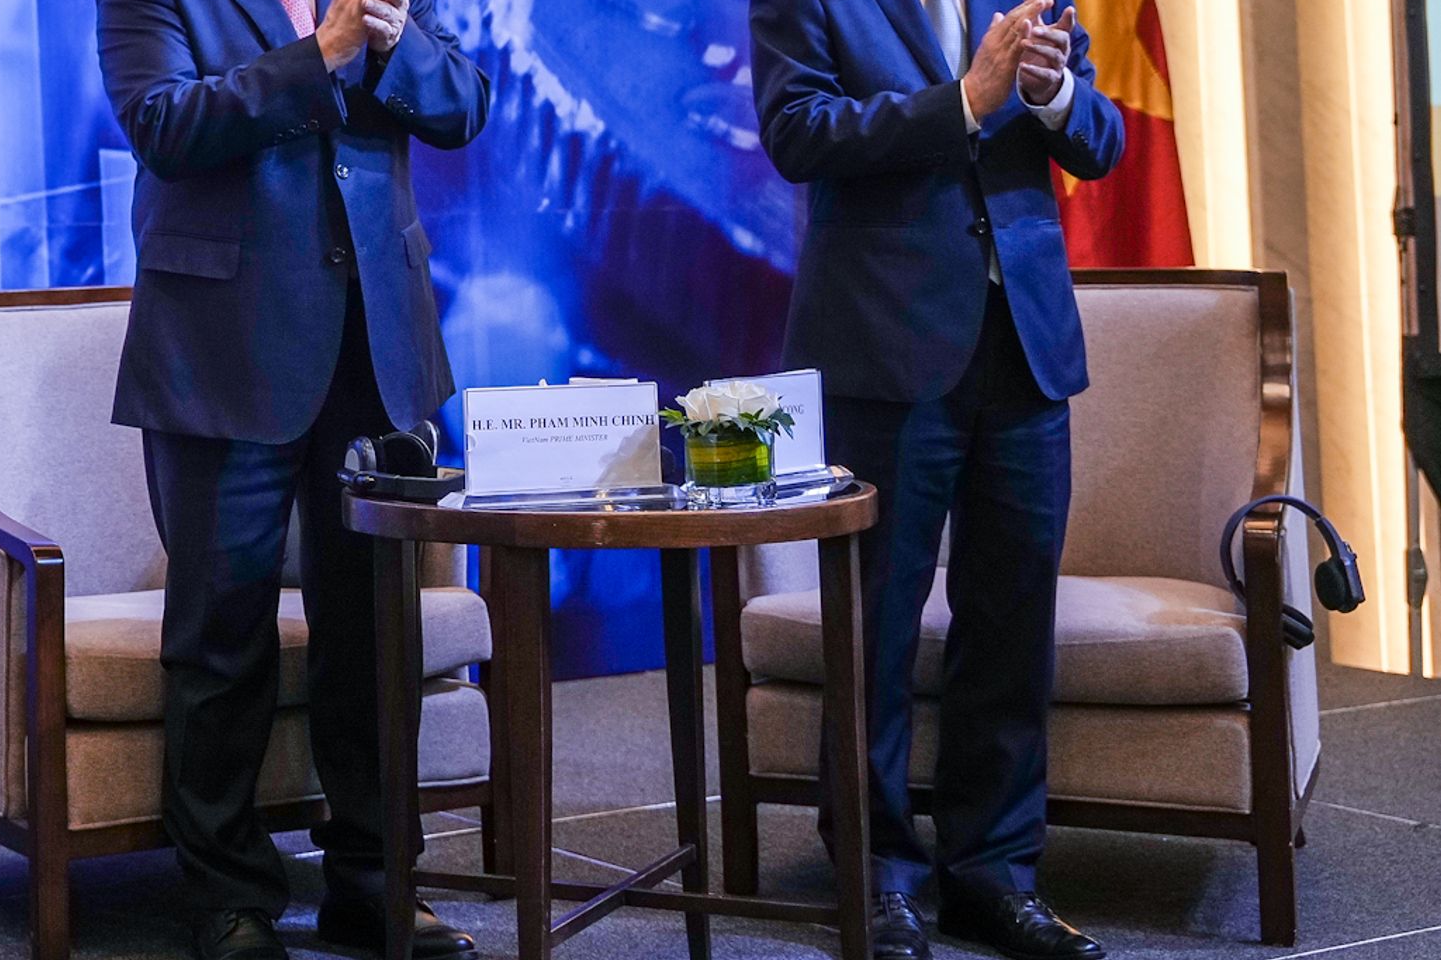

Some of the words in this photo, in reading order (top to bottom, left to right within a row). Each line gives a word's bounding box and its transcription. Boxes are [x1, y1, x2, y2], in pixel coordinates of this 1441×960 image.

[472, 419, 497, 430] H.E.
[501, 418, 526, 430] MR.
[530, 417, 568, 428] PHAM
[572, 415, 608, 427] MINH
[612, 414, 655, 426] CHINH
